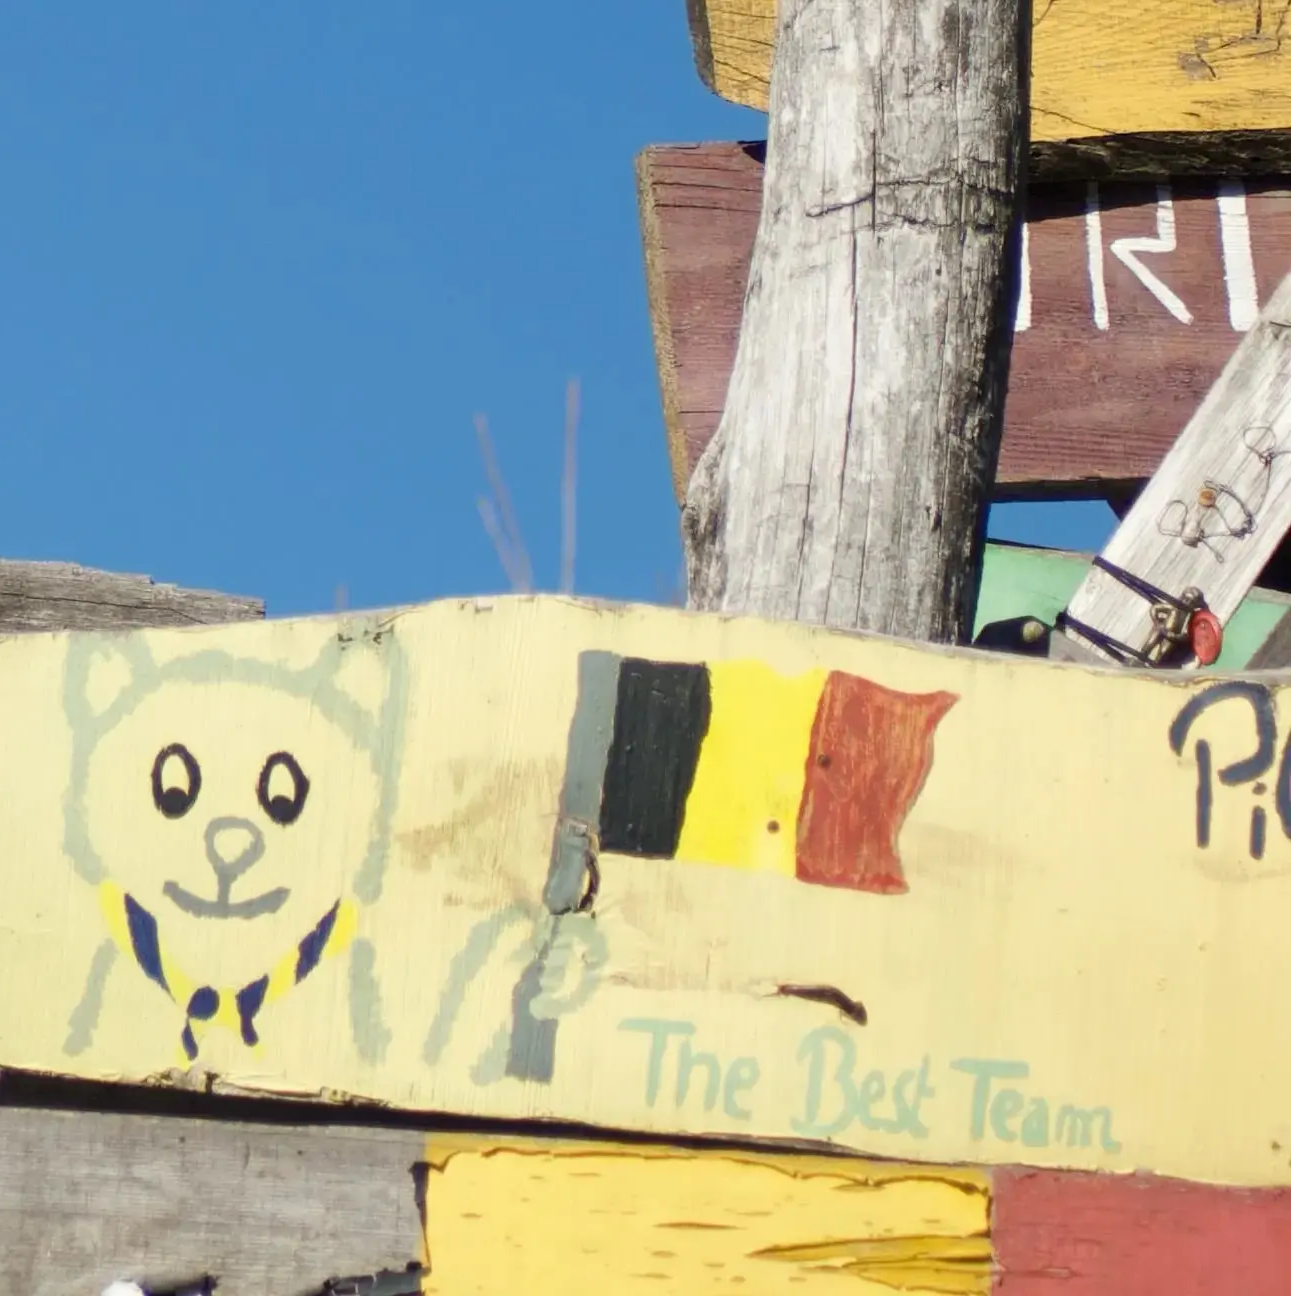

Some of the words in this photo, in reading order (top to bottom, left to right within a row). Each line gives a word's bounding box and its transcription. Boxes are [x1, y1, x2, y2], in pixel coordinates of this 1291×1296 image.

[618, 1017, 760, 1121] The
[790, 1026, 937, 1139] Best
[950, 1058, 1122, 1153] Team
